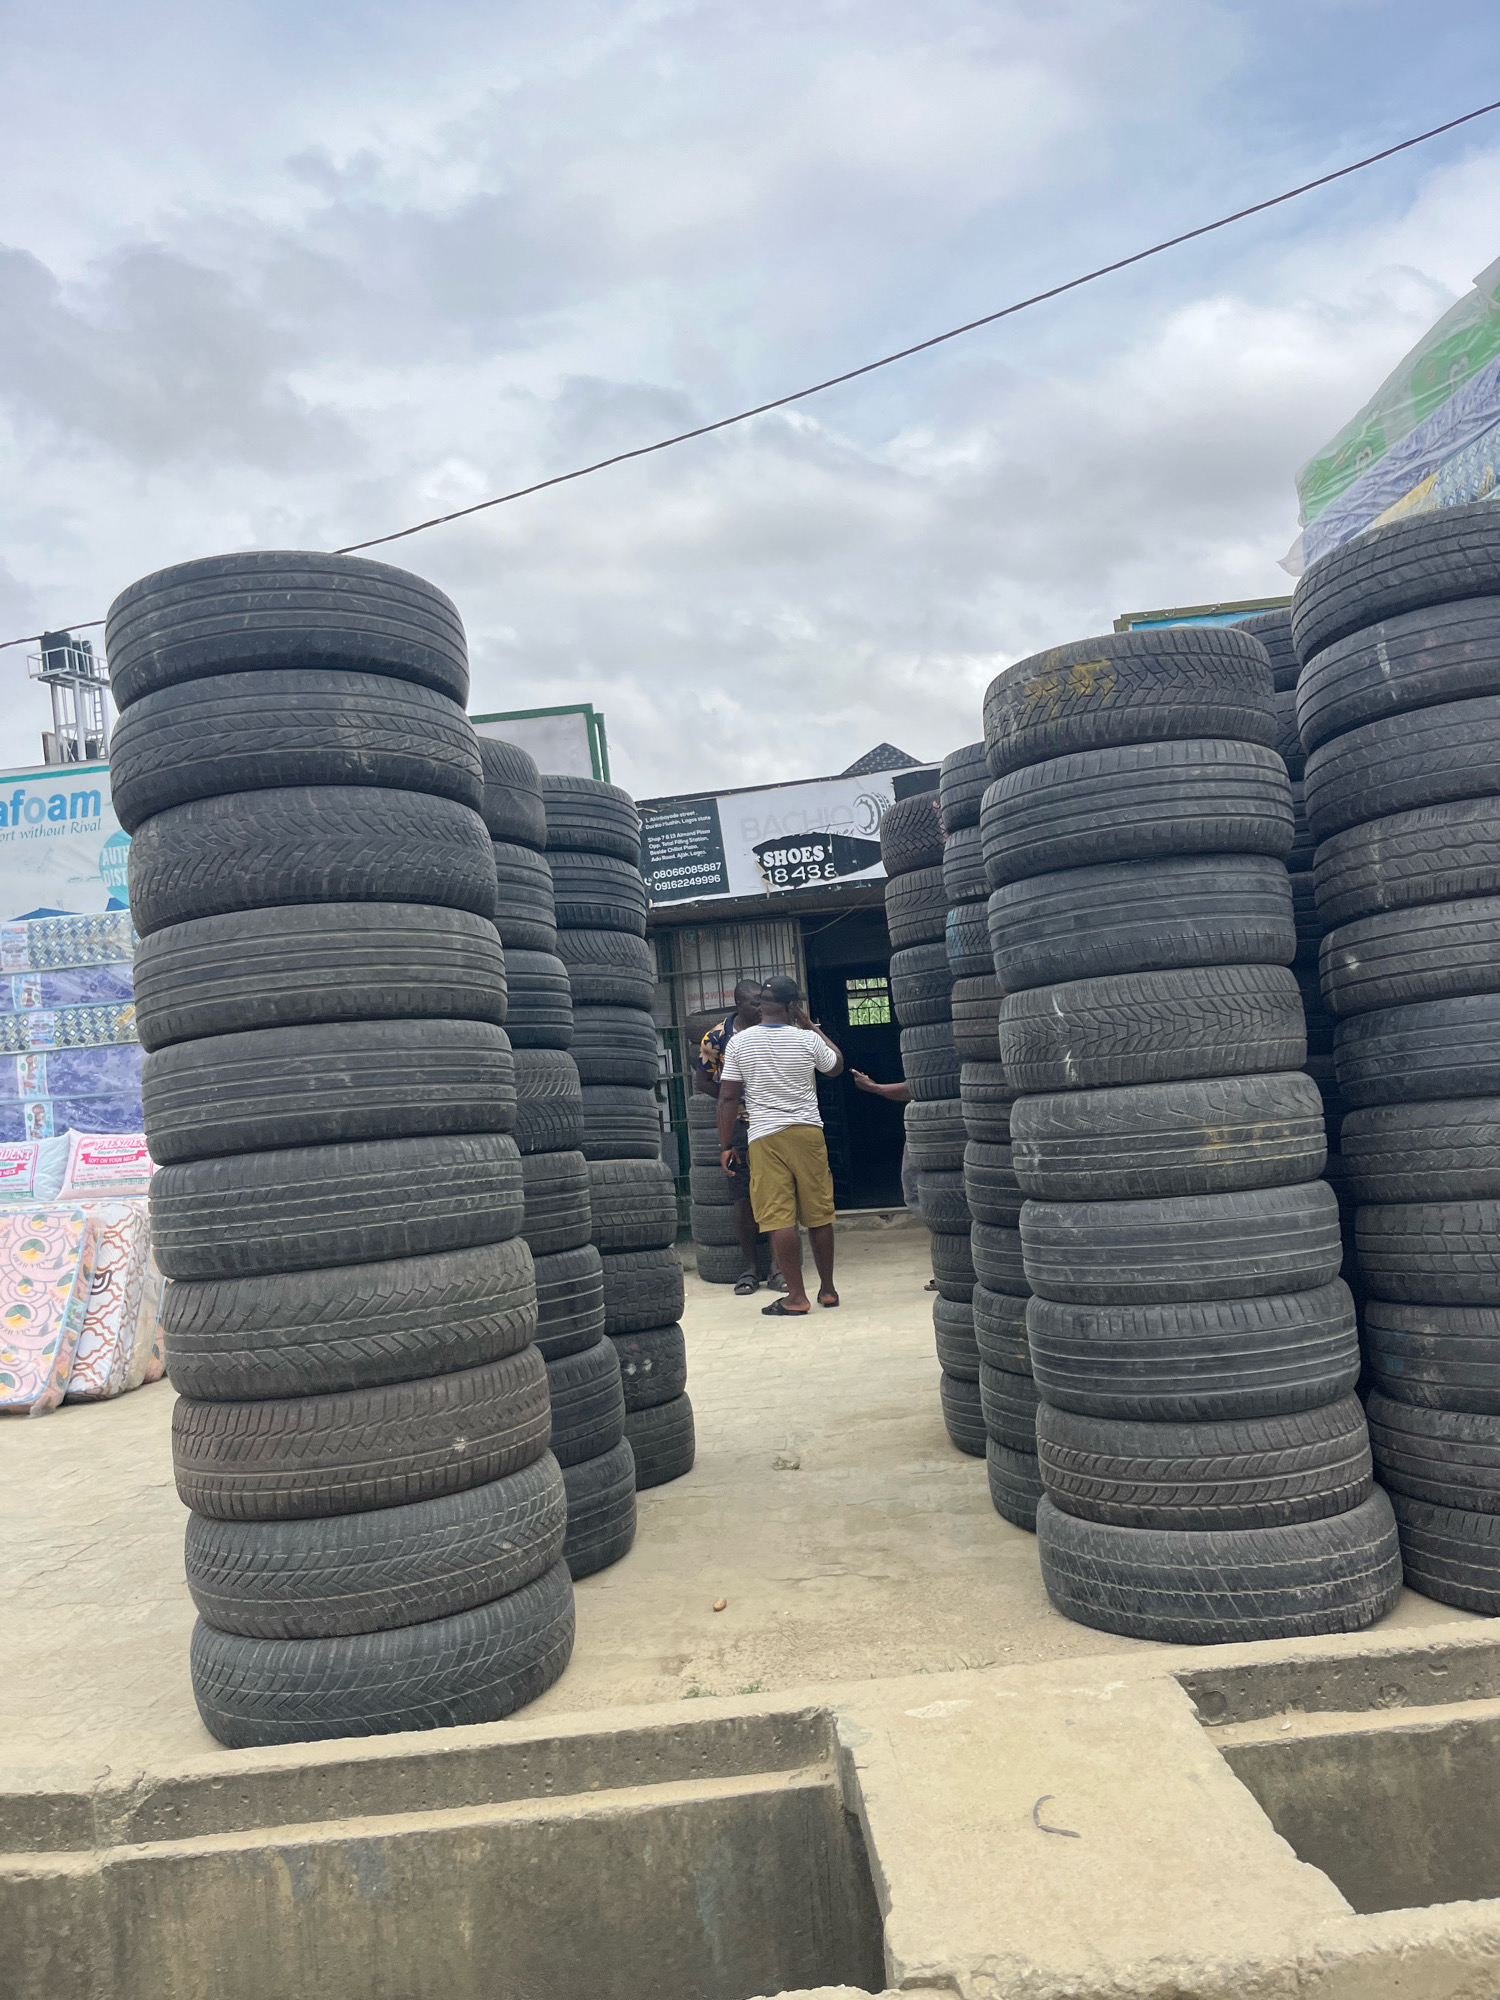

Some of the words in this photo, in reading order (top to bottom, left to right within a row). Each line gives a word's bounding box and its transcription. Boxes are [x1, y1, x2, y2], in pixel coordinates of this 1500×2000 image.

[20, 824, 66, 840] without
[71, 817, 101, 835] Rival
[763, 845, 825, 867] SHOES
[653, 862, 722, 879] 08066085887
[655, 874, 721, 891] 09162249996
